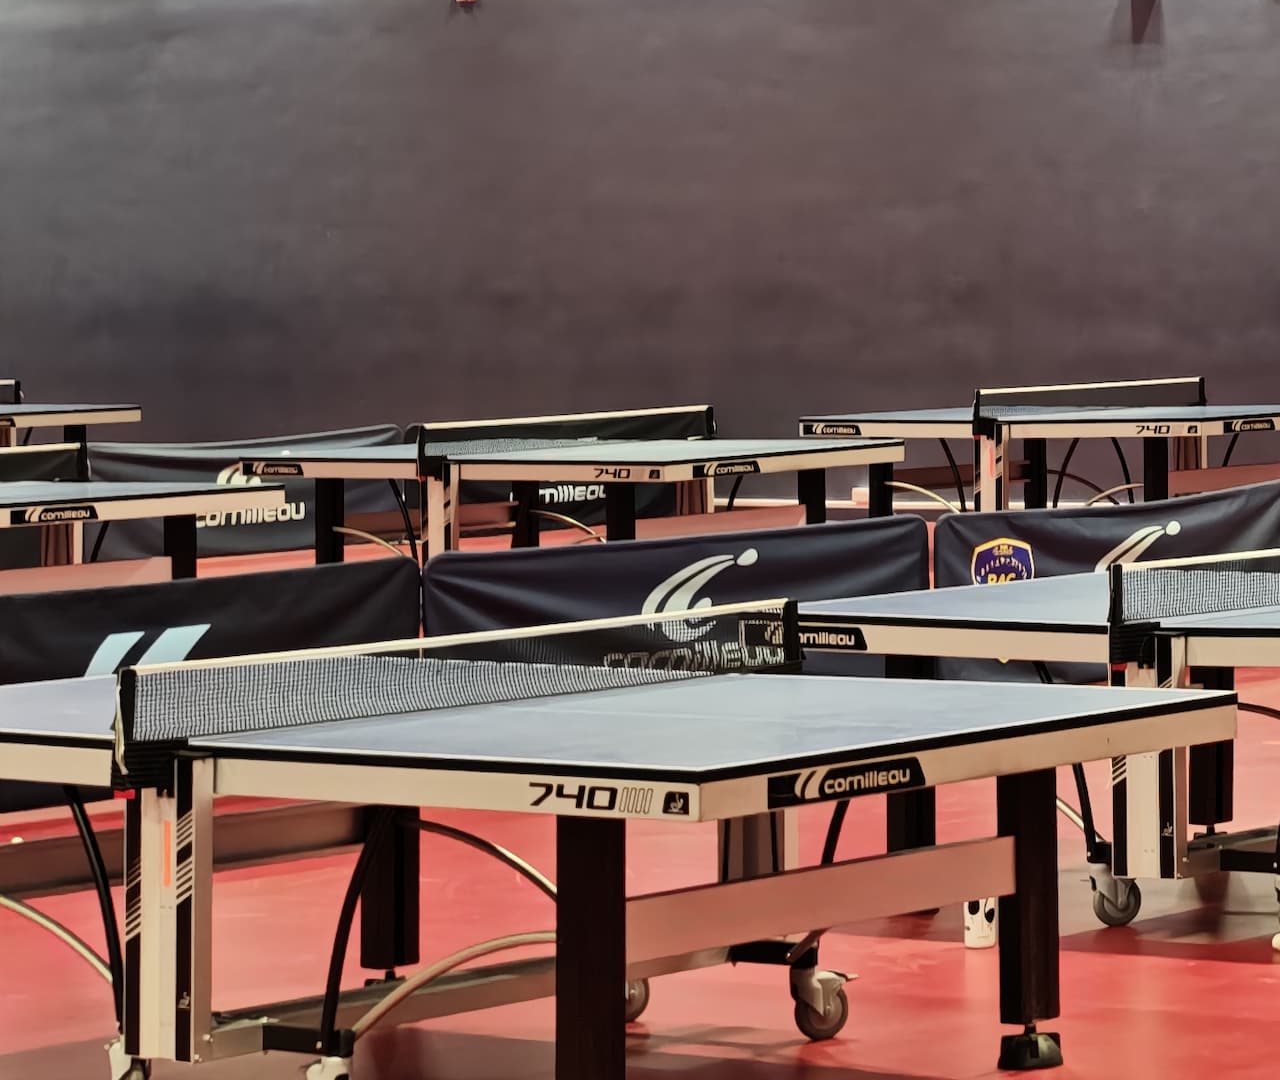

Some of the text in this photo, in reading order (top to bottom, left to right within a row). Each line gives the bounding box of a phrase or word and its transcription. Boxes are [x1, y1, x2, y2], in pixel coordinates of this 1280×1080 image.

[1135, 424, 1171, 435] 740
[593, 467, 631, 480] 740
[824, 769, 911, 795] cornilleau
[529, 782, 617, 811] 740
